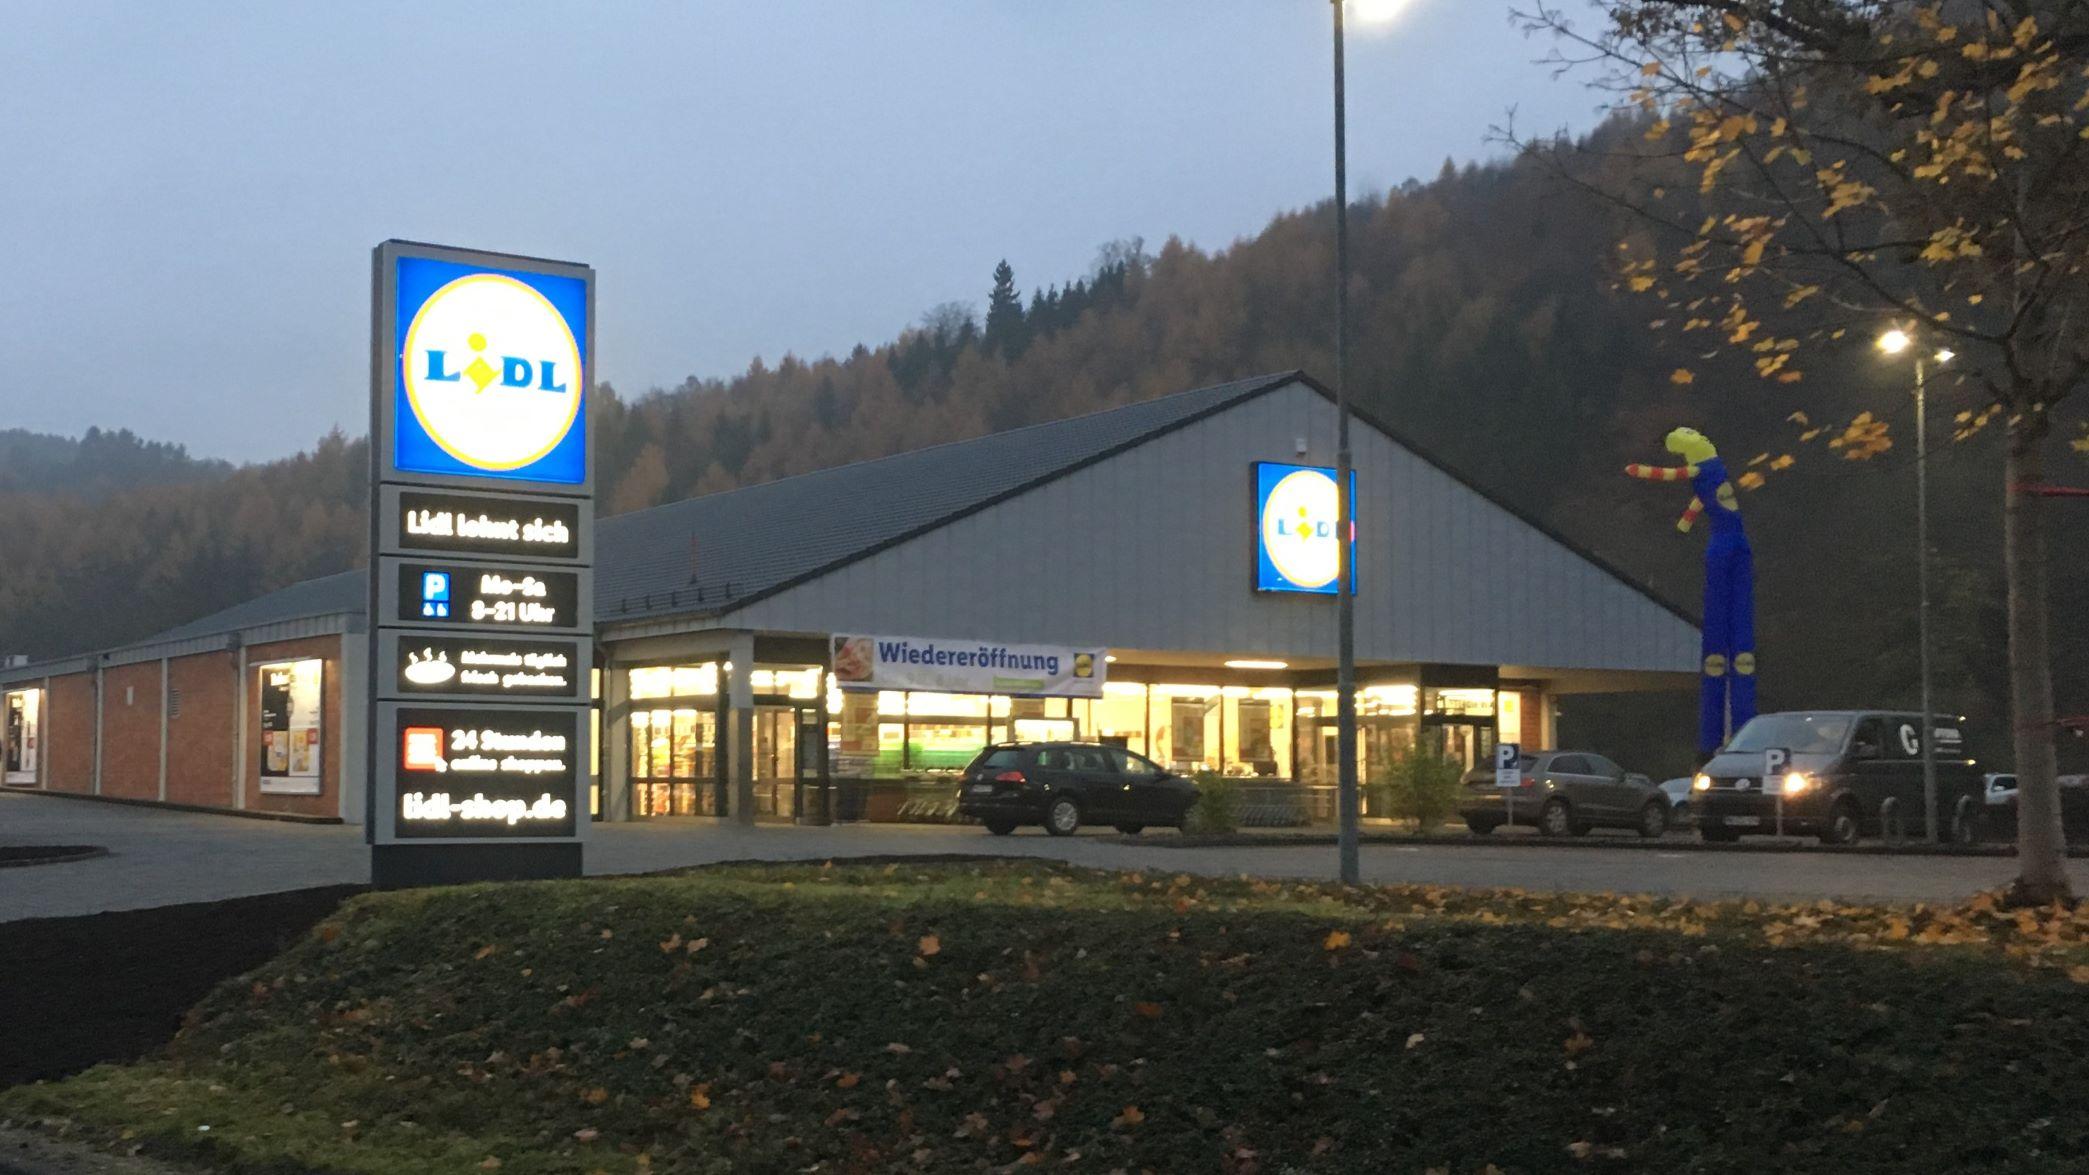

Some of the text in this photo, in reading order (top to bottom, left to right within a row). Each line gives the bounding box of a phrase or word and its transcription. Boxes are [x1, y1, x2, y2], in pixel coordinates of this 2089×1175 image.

[407, 509, 454, 536] Lidl
[522, 517, 569, 544] sich
[424, 574, 446, 600] P
[518, 602, 556, 623] Uhr
[878, 642, 1059, 675] Wiedereröffnung
[451, 729, 479, 751] 24
[1766, 749, 1786, 775] P
[403, 792, 567, 826] lidl-shop.de
